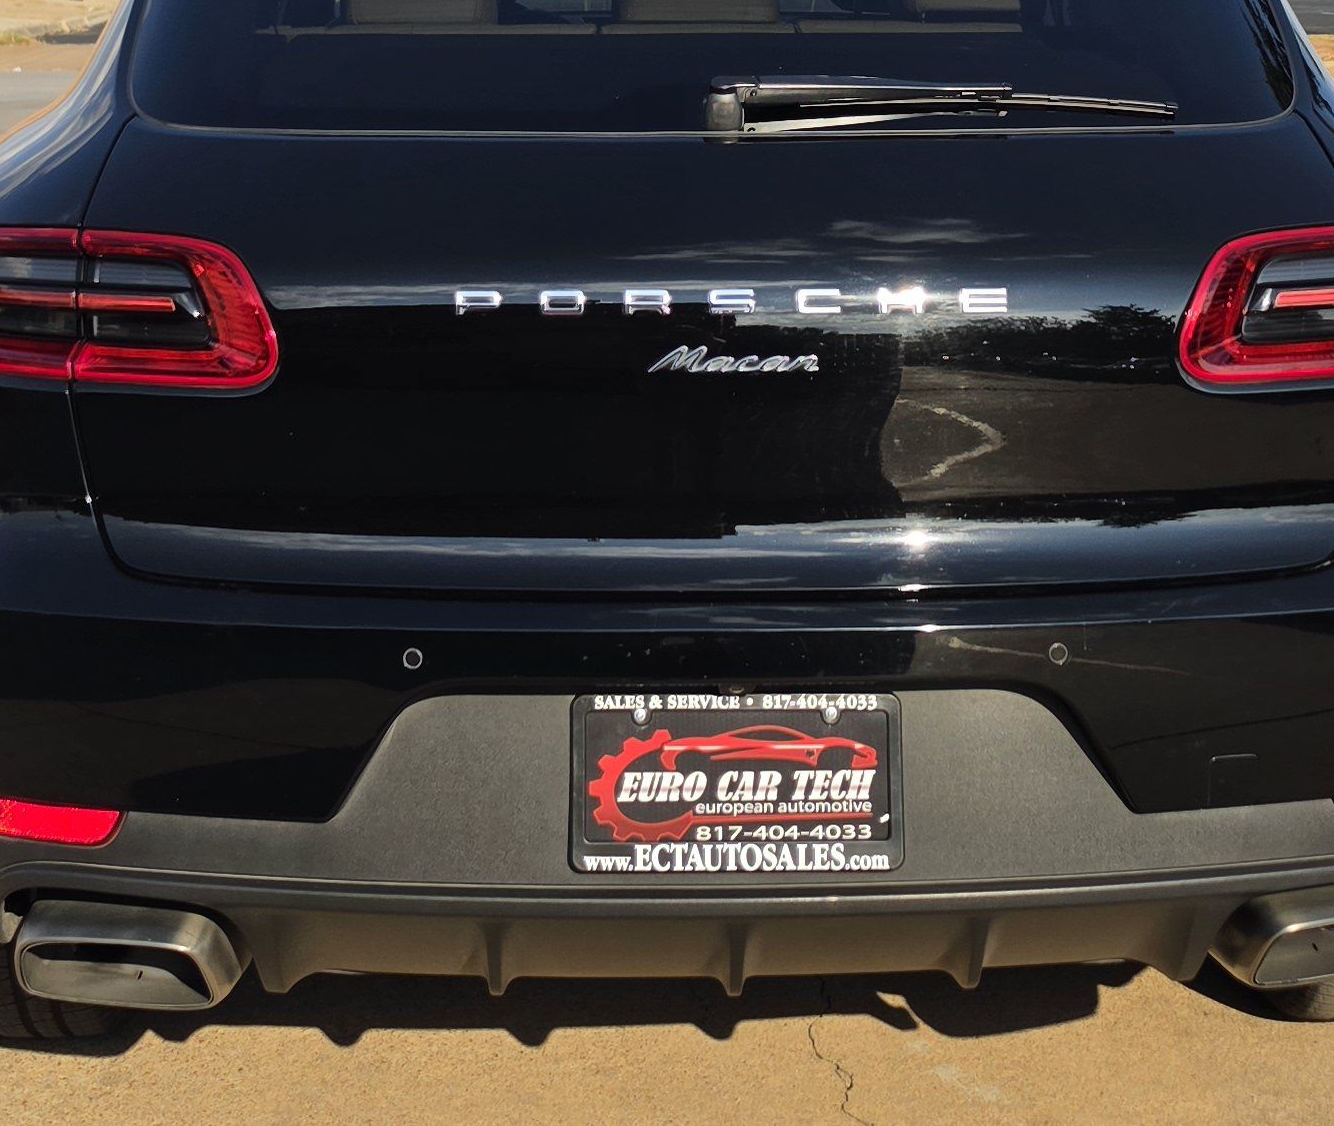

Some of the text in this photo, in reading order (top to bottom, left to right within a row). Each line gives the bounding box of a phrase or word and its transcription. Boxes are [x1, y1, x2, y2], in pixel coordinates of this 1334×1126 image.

[454, 287, 1009, 316] PORSCHE
[646, 344, 820, 374] Macan
[594, 694, 878, 711] SALES & SERVICE 817-404-4033
[616, 769, 877, 803] EURO CAR TECH
[695, 797, 873, 816] european automotive
[695, 824, 873, 841] 817-404-4033
[583, 842, 891, 872] www.ECTAUTOSALES.com
